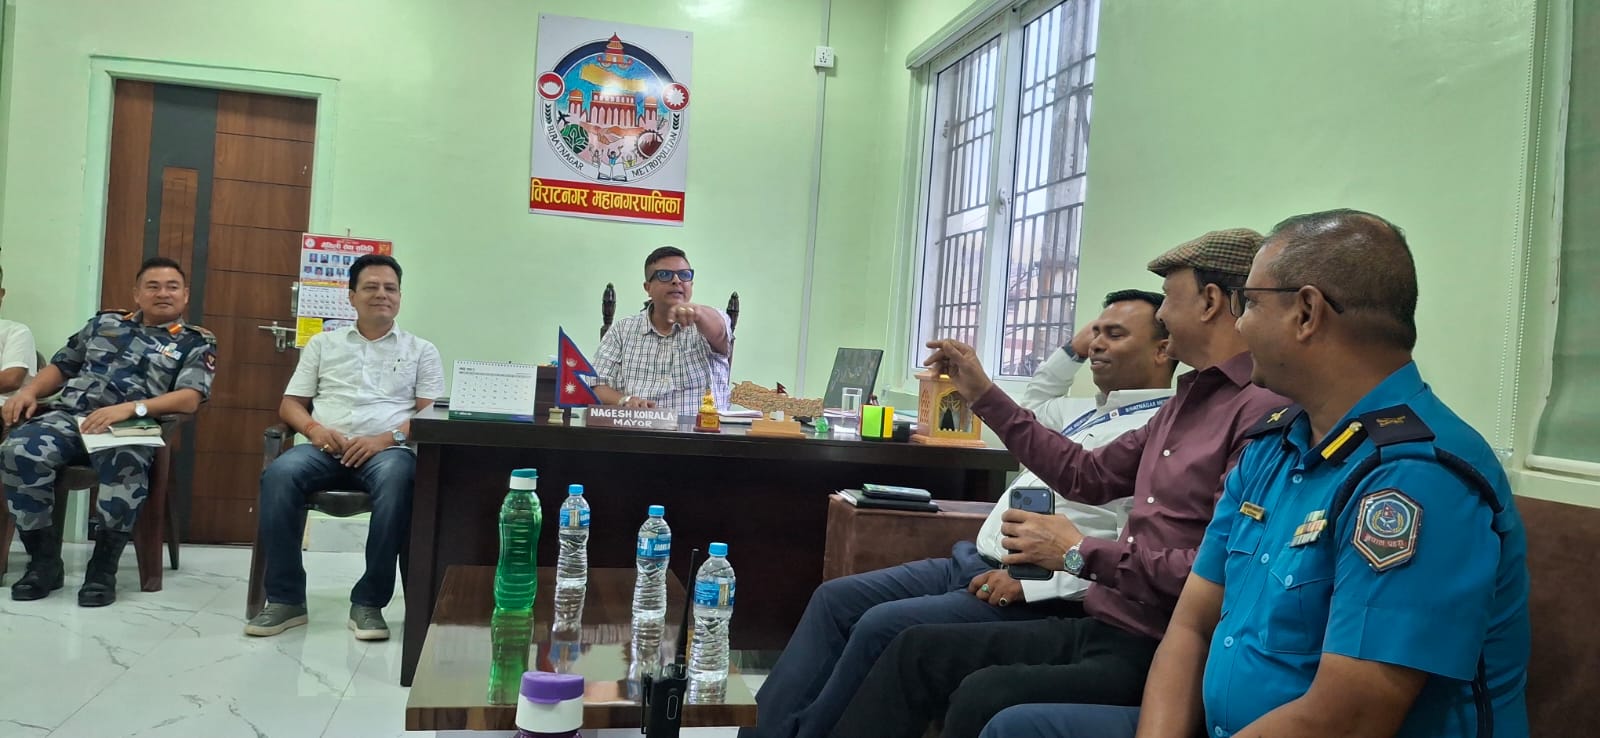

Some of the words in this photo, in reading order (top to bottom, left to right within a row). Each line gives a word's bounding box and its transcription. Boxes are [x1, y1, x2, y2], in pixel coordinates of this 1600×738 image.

[547, 125, 584, 171] BIRATNAGAR
[631, 131, 678, 177] METROPOLITAN
[531, 178, 589, 206] विराटनगर
[592, 190, 681, 214] महानगरपालिका
[590, 408, 632, 418] NAGESH
[633, 411, 673, 420] KOIRALA
[613, 418, 652, 428] MAYOR
